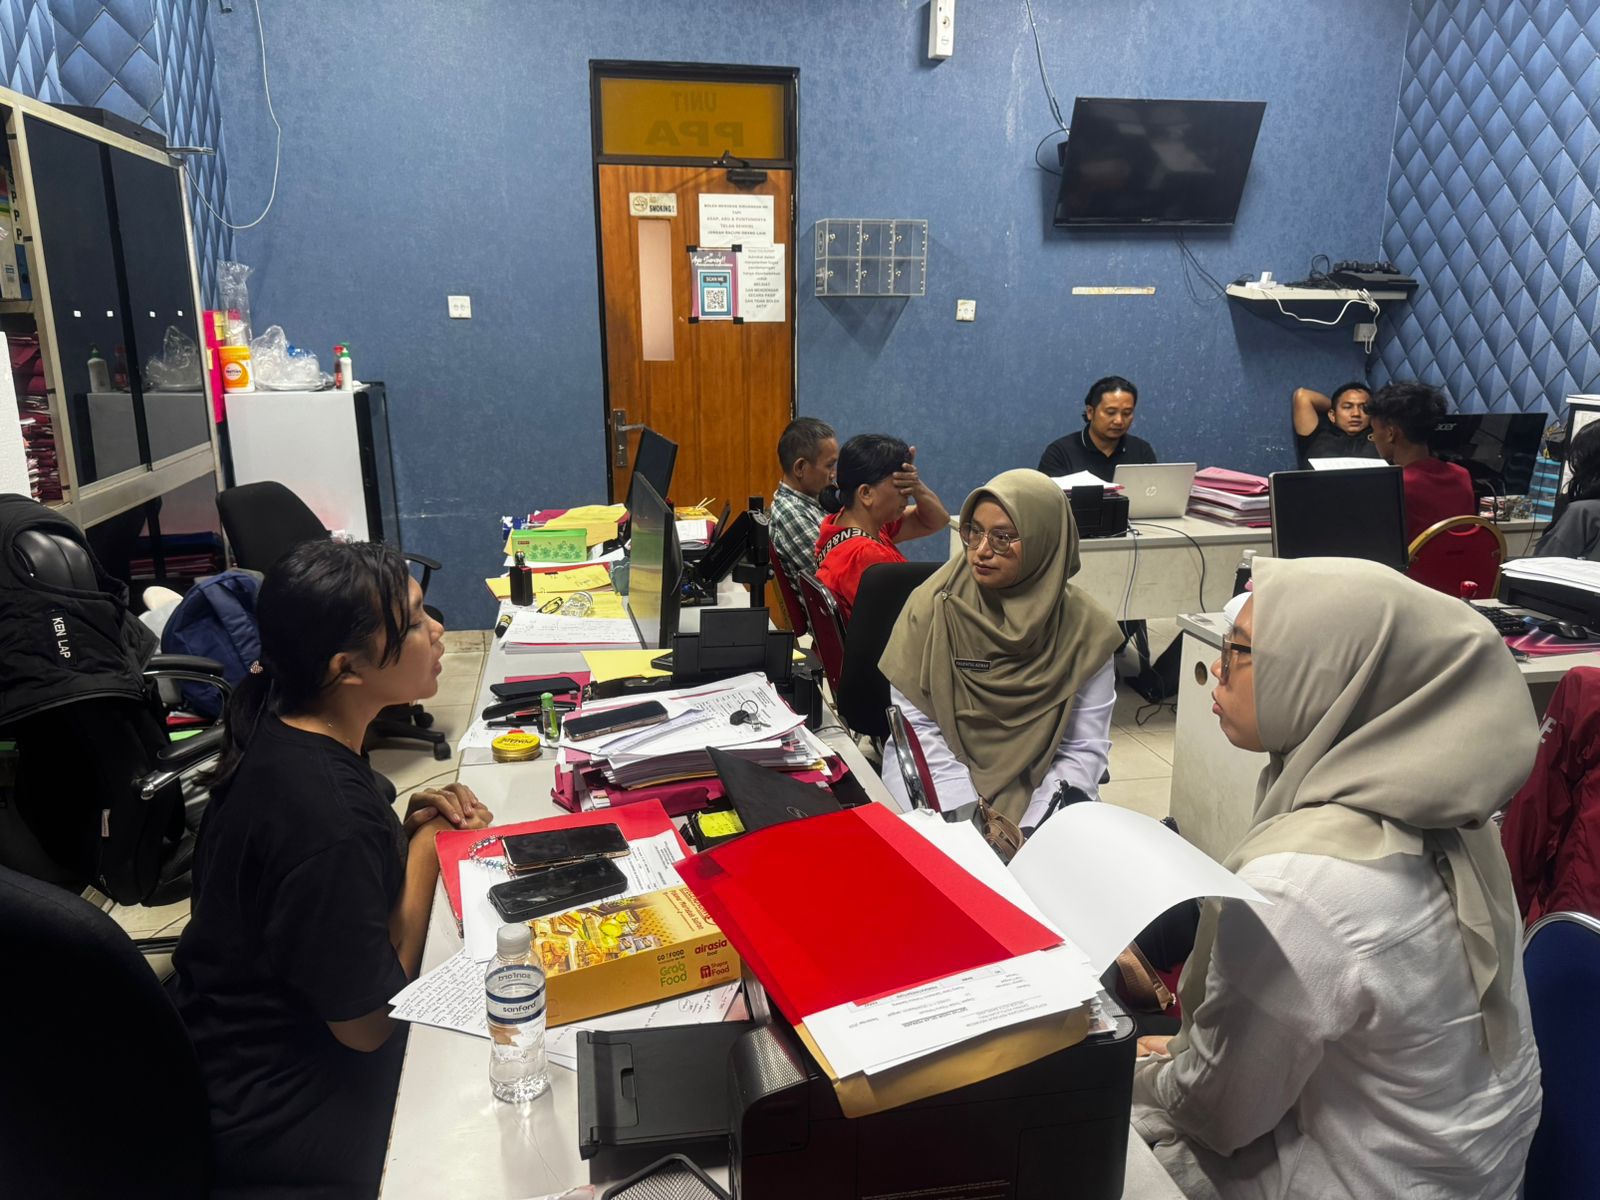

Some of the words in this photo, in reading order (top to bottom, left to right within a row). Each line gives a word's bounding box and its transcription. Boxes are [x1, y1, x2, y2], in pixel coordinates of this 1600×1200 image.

[52, 616, 67, 637] KEN
[58, 640, 71, 658] LAP
[694, 940, 727, 954] airasia
[660, 961, 686, 976] Grab
[711, 965, 730, 976] Food
[660, 970, 687, 987] Food
[503, 1000, 536, 1013] sanford
